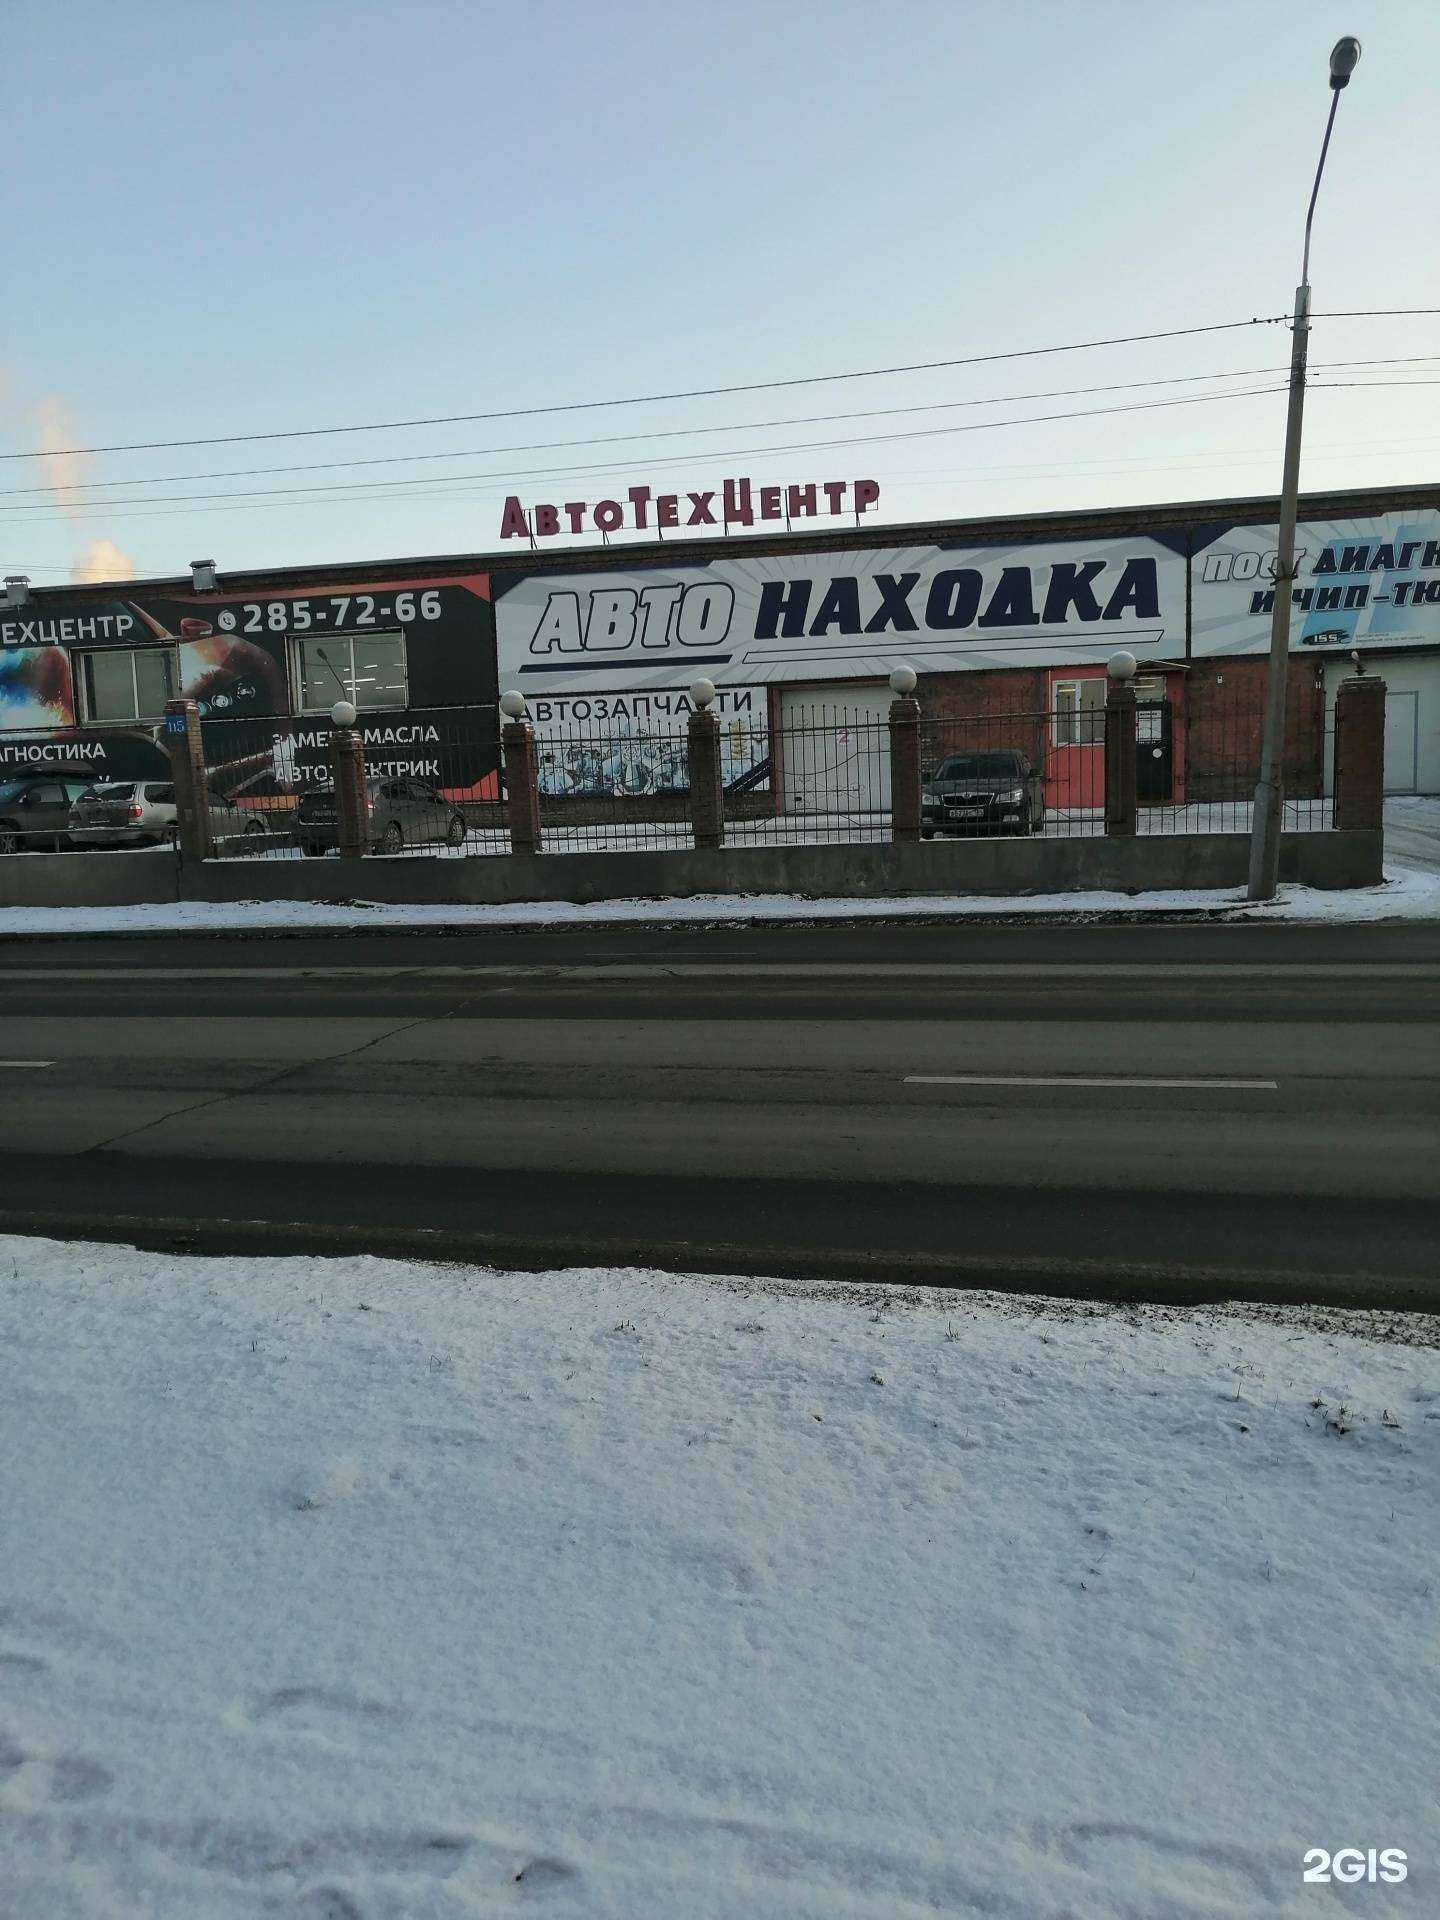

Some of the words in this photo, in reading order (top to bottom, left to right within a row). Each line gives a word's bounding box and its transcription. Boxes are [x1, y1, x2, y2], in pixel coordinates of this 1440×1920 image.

[243, 591, 441, 632] 285-72-66
[530, 581, 736, 655] АВТО
[753, 556, 1164, 641] НАХОДКА
[1, 615, 134, 645] ЕХЦЕНТР
[520, 691, 752, 722] АВТОЗАПЧАТИ
[364, 725, 441, 745] МАСЛА
